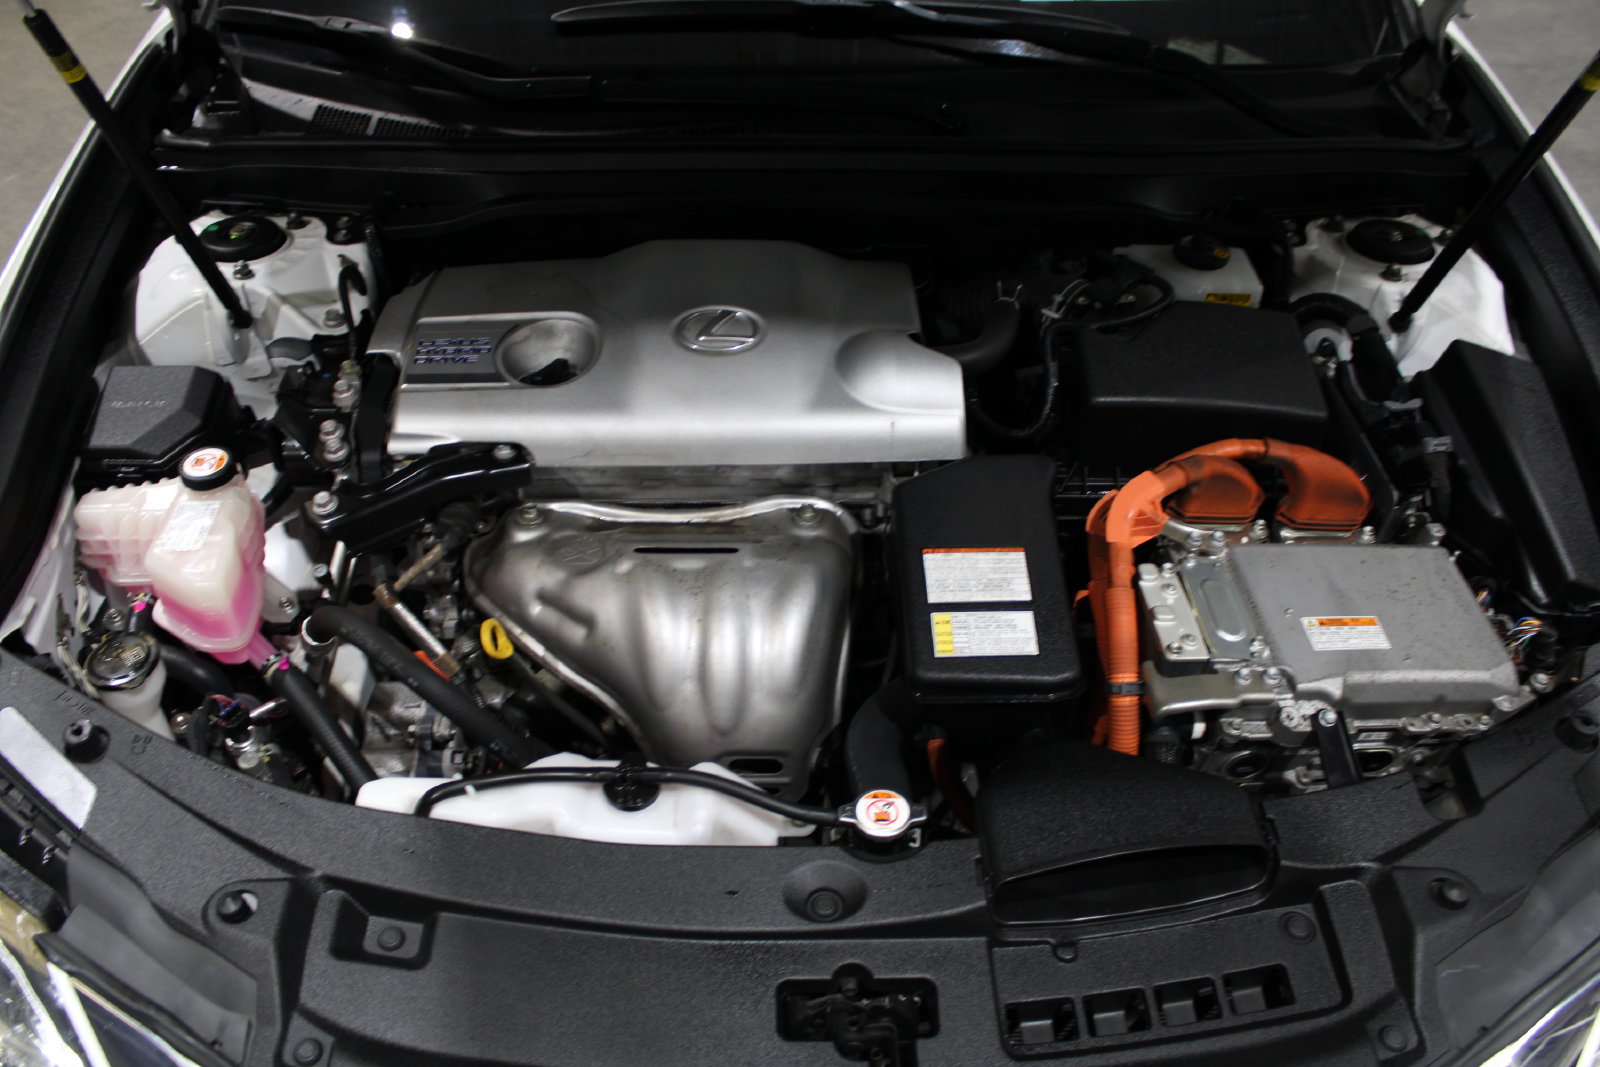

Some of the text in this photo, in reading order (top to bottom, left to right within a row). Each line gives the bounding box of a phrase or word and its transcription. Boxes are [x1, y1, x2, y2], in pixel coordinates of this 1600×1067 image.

[418, 337, 490, 346] LEXUS
[416, 345, 492, 355] HYBRID
[415, 354, 480, 364] DRIVE
